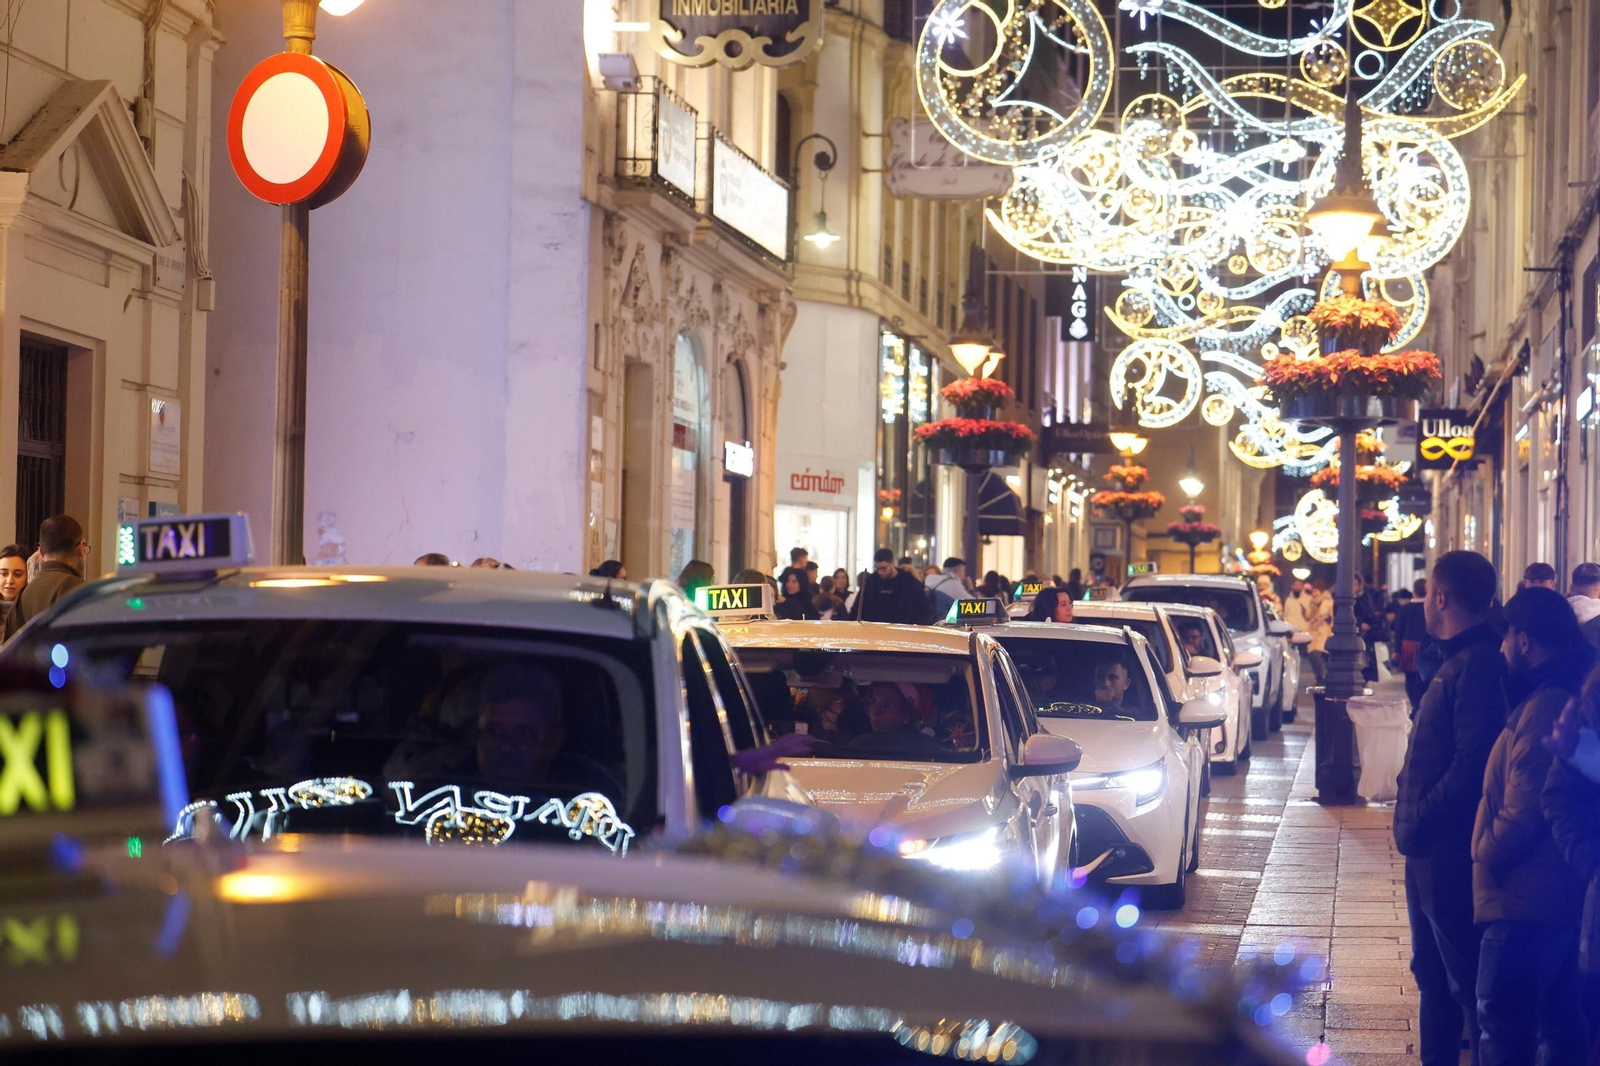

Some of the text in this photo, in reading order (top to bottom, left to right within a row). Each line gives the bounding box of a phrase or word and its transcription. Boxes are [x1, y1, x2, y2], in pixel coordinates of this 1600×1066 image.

[672, 0, 799, 16] INMOBILIARIA
[1422, 418, 1474, 437] Ulloa
[790, 467, 845, 494] cóndor
[140, 522, 205, 560] TAXI
[1023, 583, 1043, 593] TAXI
[708, 588, 748, 610] TAXI
[959, 601, 986, 614] TAXI
